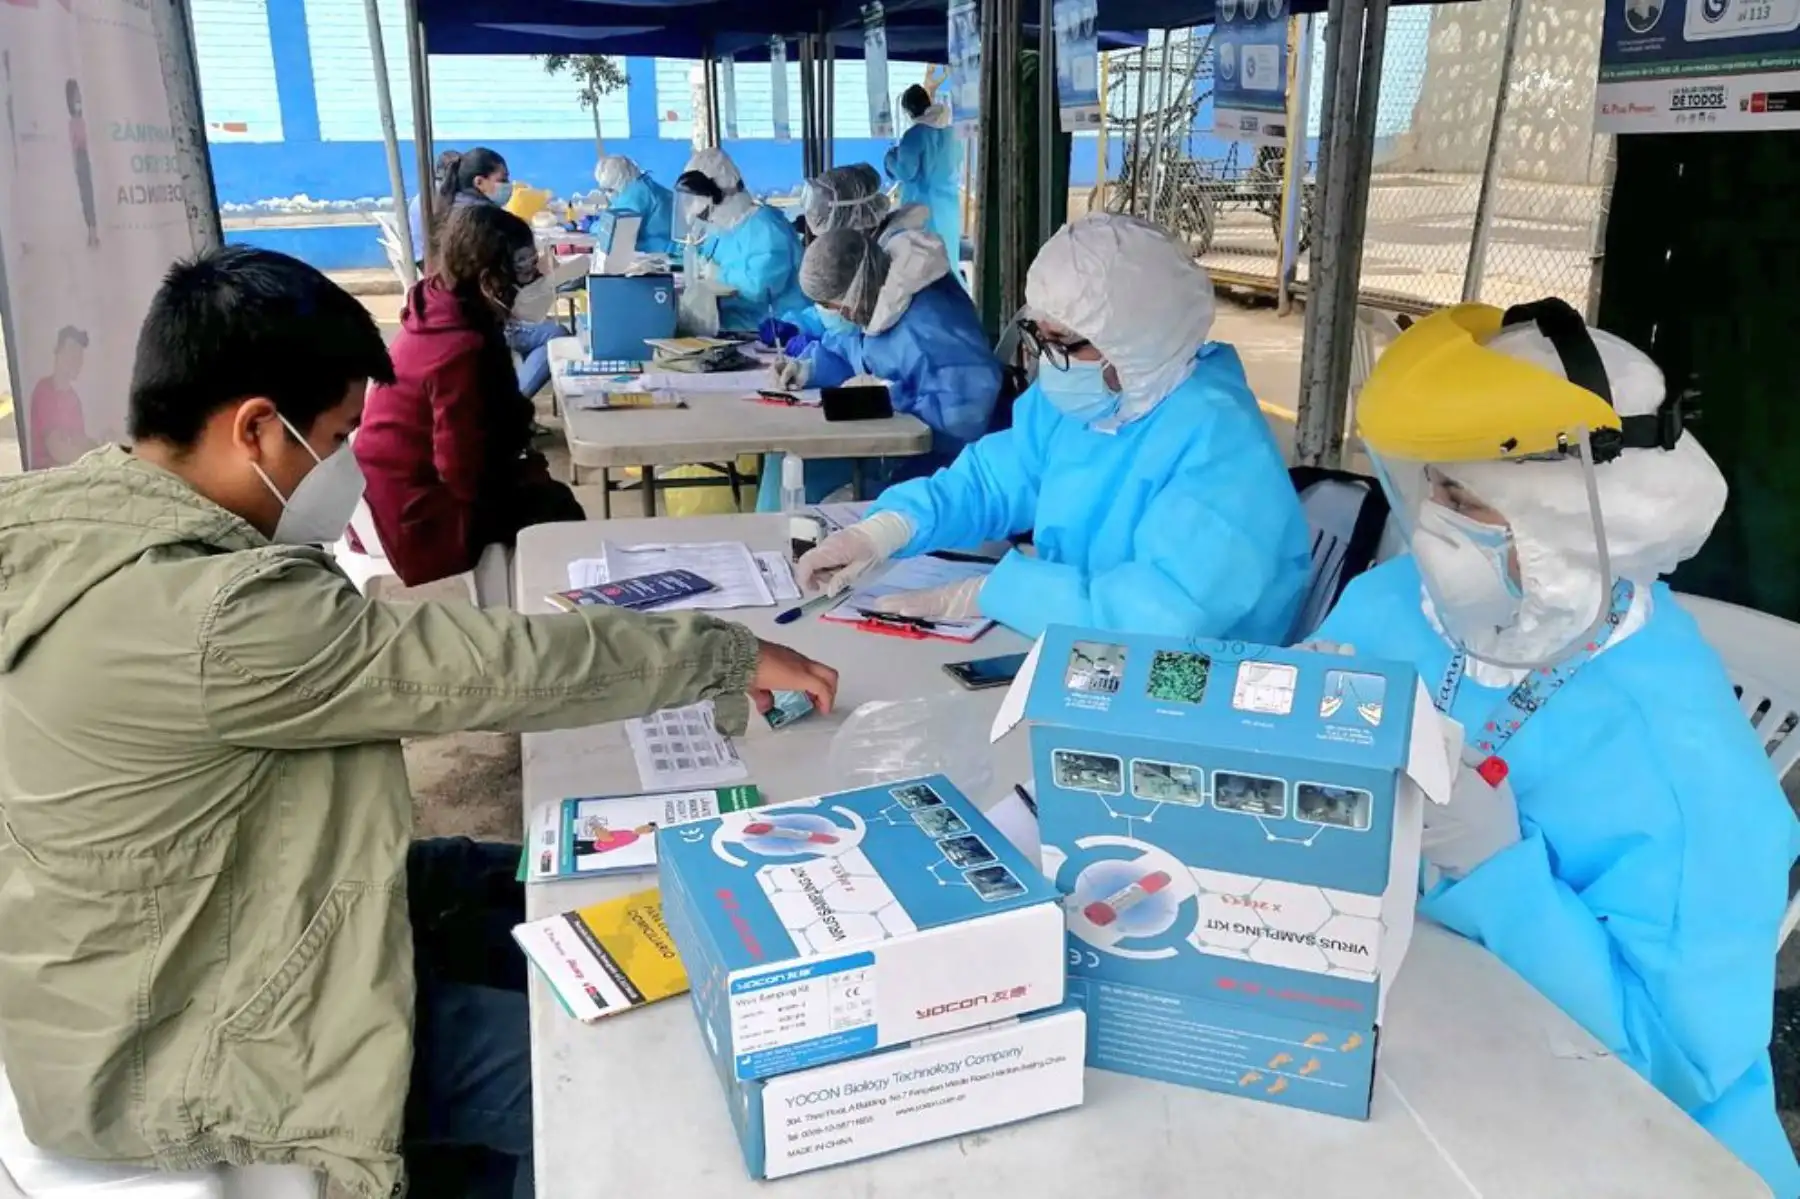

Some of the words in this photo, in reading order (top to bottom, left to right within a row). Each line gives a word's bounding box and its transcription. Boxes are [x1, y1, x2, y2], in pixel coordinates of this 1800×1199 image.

[1749, 6, 1771, 20] 113
[1672, 95, 1685, 106] DE
[1688, 93, 1723, 105] TODOS
[798, 876, 832, 917] SAMPLING
[822, 914, 846, 942] VIRUS
[1204, 918, 1229, 931] KIT
[1231, 922, 1316, 946] SAMPLING
[1318, 936, 1369, 956] VIRUS
[785, 1084, 841, 1109] YOCON
[844, 1076, 890, 1098] Biology
[892, 1059, 963, 1084] Technology
[964, 1046, 1024, 1068] Company
[786, 1146, 813, 1158] MADE
[824, 1136, 854, 1150] CHINA
